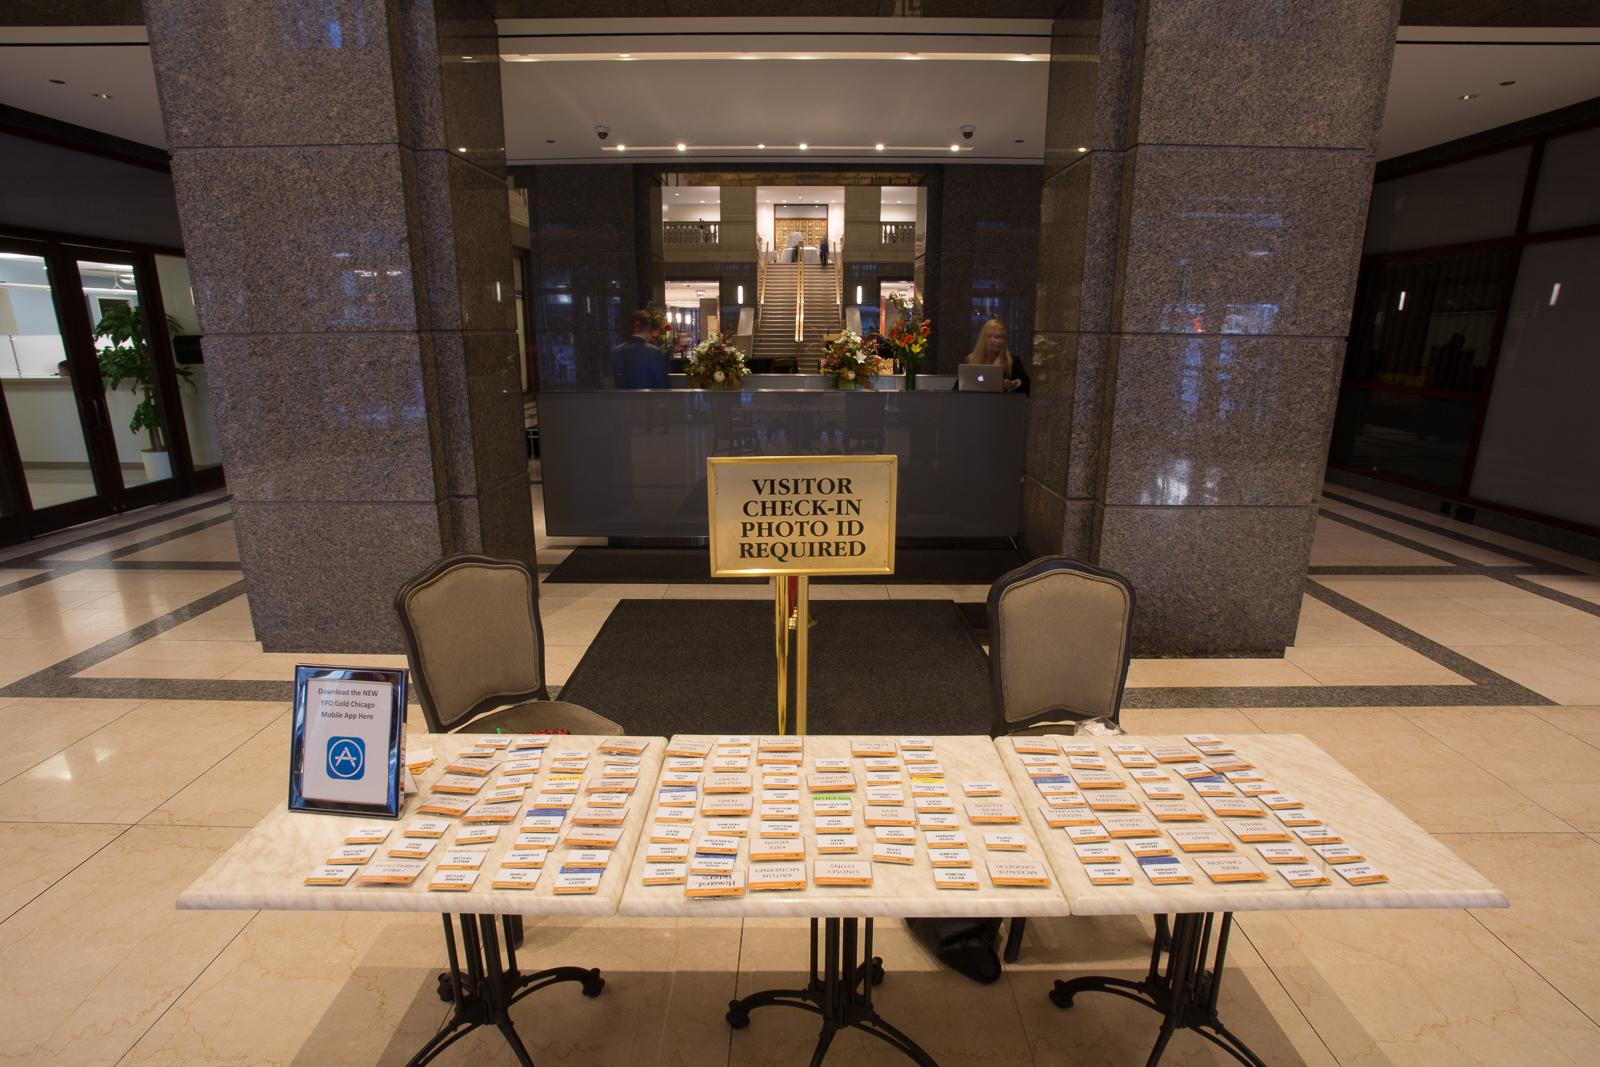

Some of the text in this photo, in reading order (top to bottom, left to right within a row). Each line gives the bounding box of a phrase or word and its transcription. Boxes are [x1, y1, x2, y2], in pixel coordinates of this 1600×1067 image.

[751, 478, 853, 495] VISITOR
[742, 499, 862, 517] CHECK-IN
[740, 519, 864, 538] PHOTO ID
[739, 541, 866, 562] REQUIRED
[350, 701, 376, 709] Chicago
